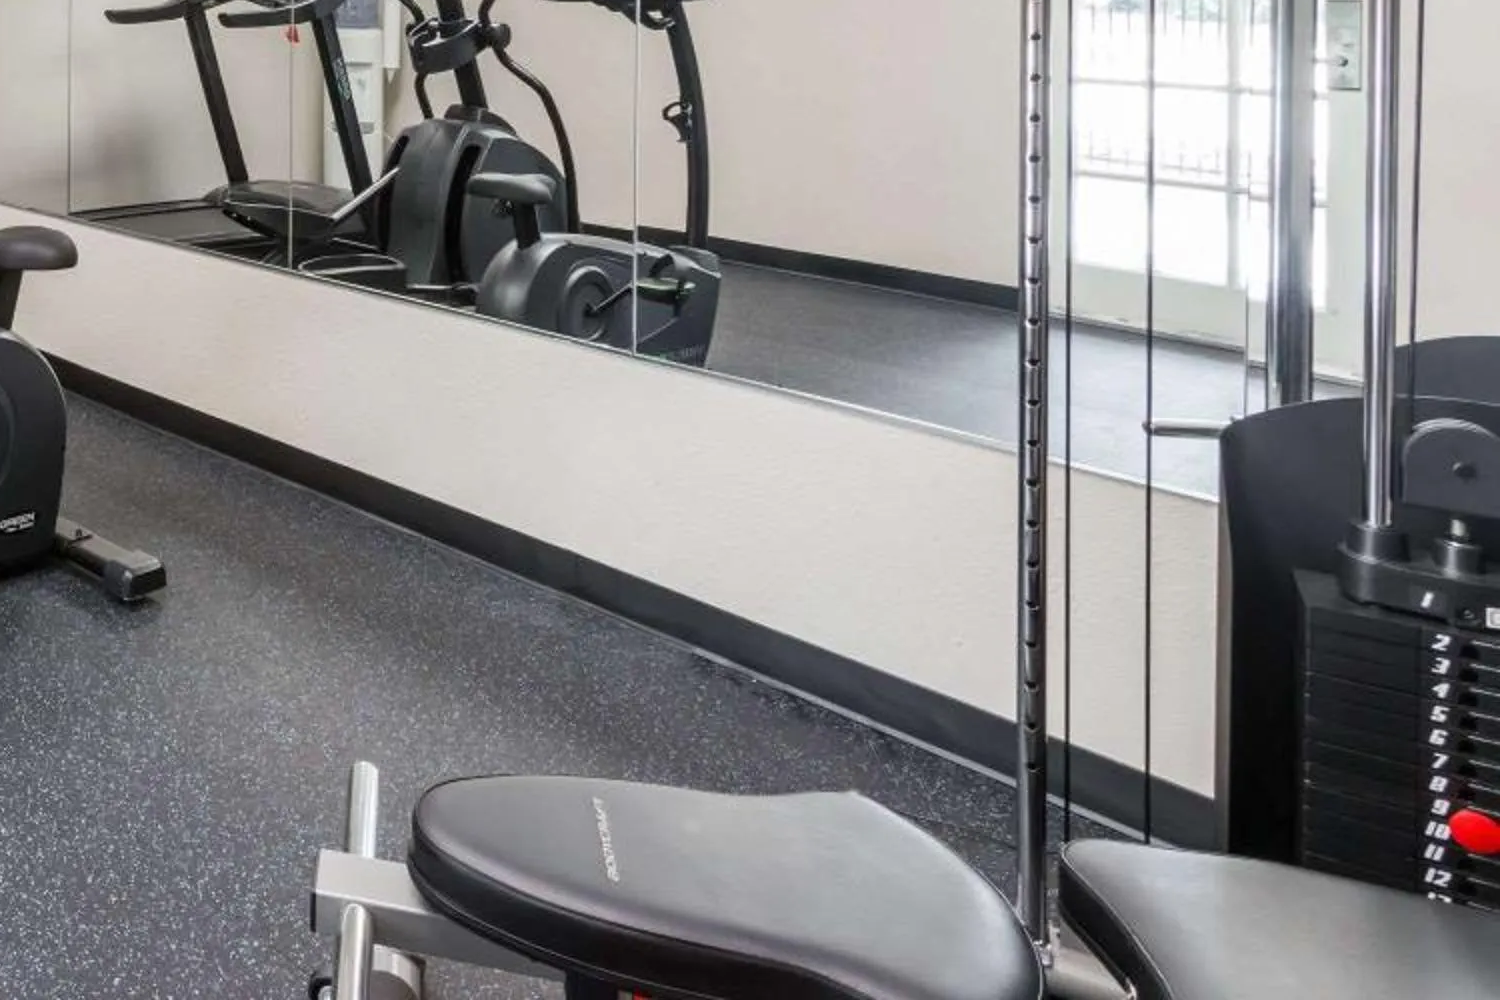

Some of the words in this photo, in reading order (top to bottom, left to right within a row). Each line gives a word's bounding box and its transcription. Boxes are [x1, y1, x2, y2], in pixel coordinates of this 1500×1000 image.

[1420, 591, 1435, 609] 1
[1431, 633, 1452, 652] 2
[1430, 657, 1451, 675] 3
[1431, 682, 1451, 699] 4
[1430, 705, 1451, 723] 5
[1428, 728, 1449, 746] 6
[1431, 752, 1449, 769] 7
[1428, 775, 1449, 793] 8
[1430, 798, 1451, 816] 9
[1424, 820, 1452, 841] 10
[1423, 843, 1446, 862] 11
[1423, 867, 1453, 888] 12
